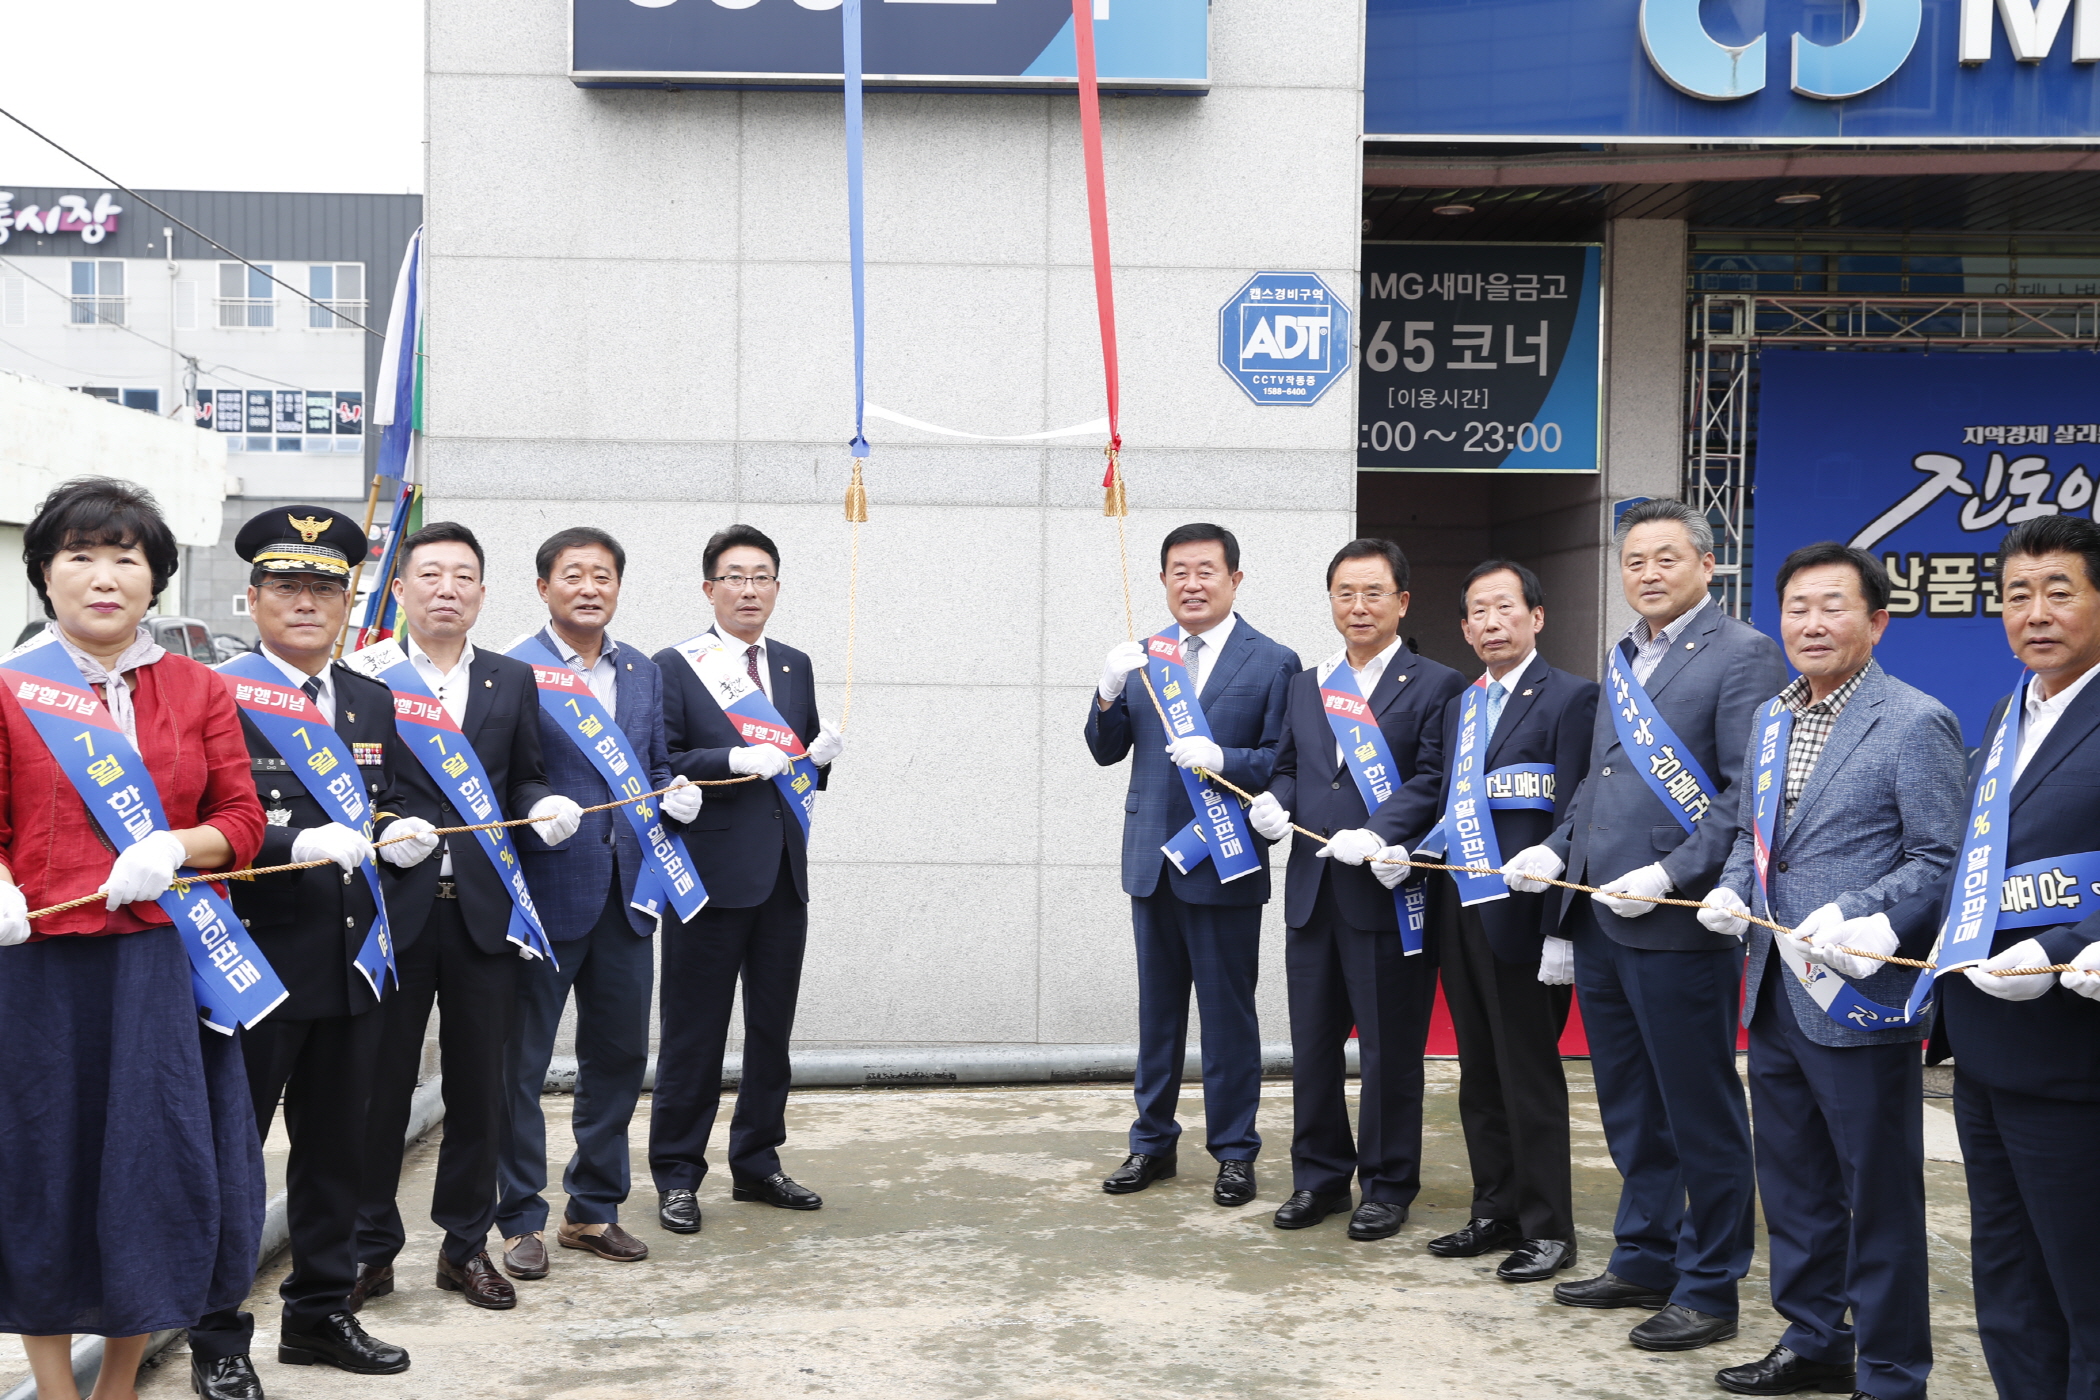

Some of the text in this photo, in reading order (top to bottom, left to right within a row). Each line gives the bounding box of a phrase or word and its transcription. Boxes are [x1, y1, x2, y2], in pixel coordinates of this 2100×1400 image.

[1249, 287, 1324, 301] 캡스경비구역
[1241, 314, 1331, 360] ADT
[1359, 319, 1549, 377] 65 코너
[1263, 387, 1307, 396] 1588-6400
[1962, 423, 2100, 445] 지역경제 살리
[17, 681, 99, 716] 발행기념
[235, 683, 306, 712] 발행기념
[1325, 694, 1367, 716] 발행기념
[741, 722, 794, 747] 발행기념
[1167, 699, 1196, 736] 한달
[1459, 721, 1477, 757] 한달
[326, 772, 365, 822] 한달
[458, 776, 493, 820] 한달
[1362, 762, 1393, 804] 한달
[594, 735, 630, 776] 한달
[646, 822, 695, 897] 할인판매
[1453, 798, 1493, 880] 할인판매
[1952, 845, 1992, 944] 할인판매
[187, 898, 262, 994] 할인판매
